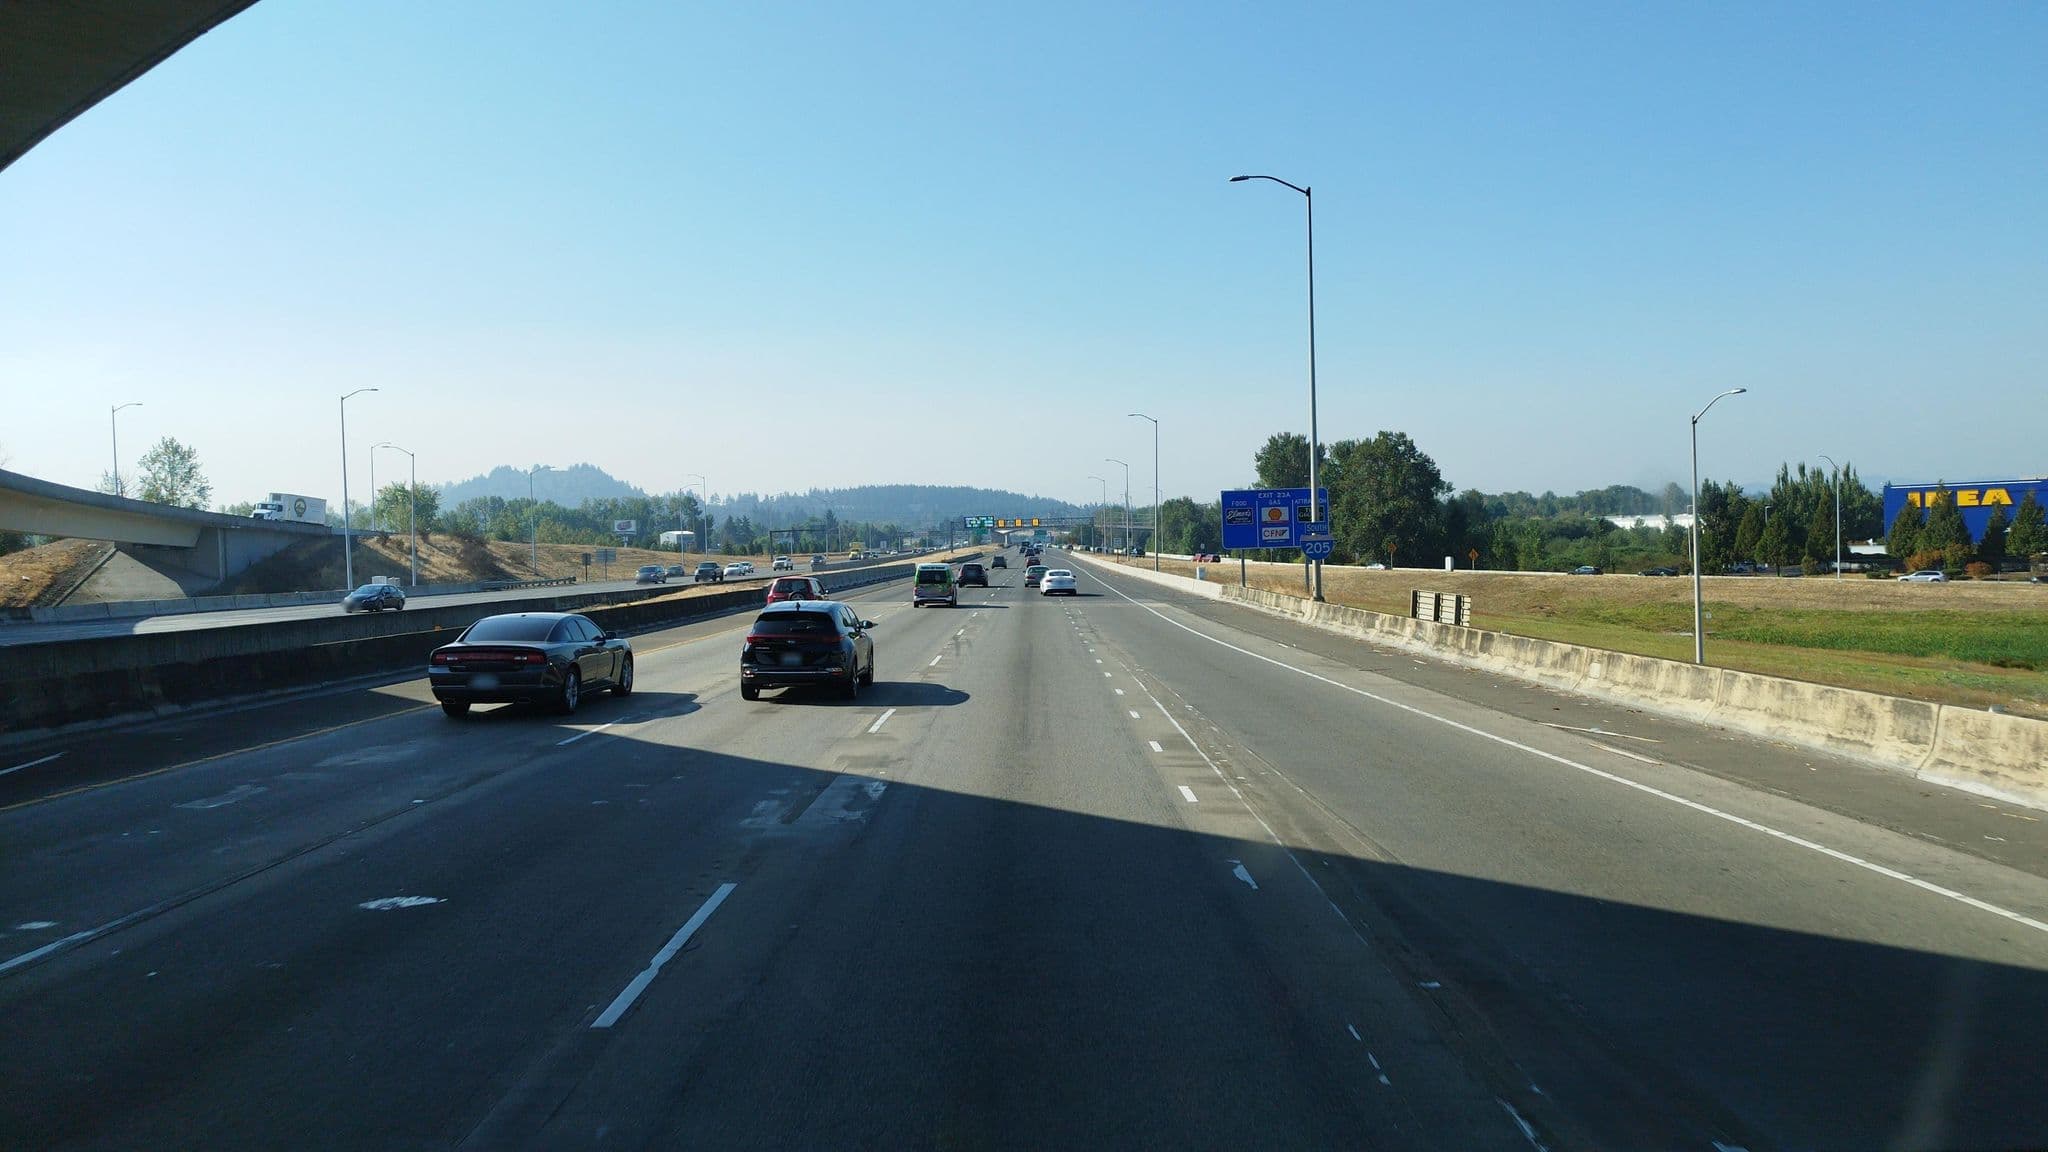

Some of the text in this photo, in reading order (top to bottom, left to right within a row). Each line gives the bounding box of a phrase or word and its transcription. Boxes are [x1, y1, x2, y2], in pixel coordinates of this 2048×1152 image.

[1306, 524, 1327, 532] SOUTH
[1263, 529, 1282, 538] CFN
[1305, 542, 1330, 554] 205
